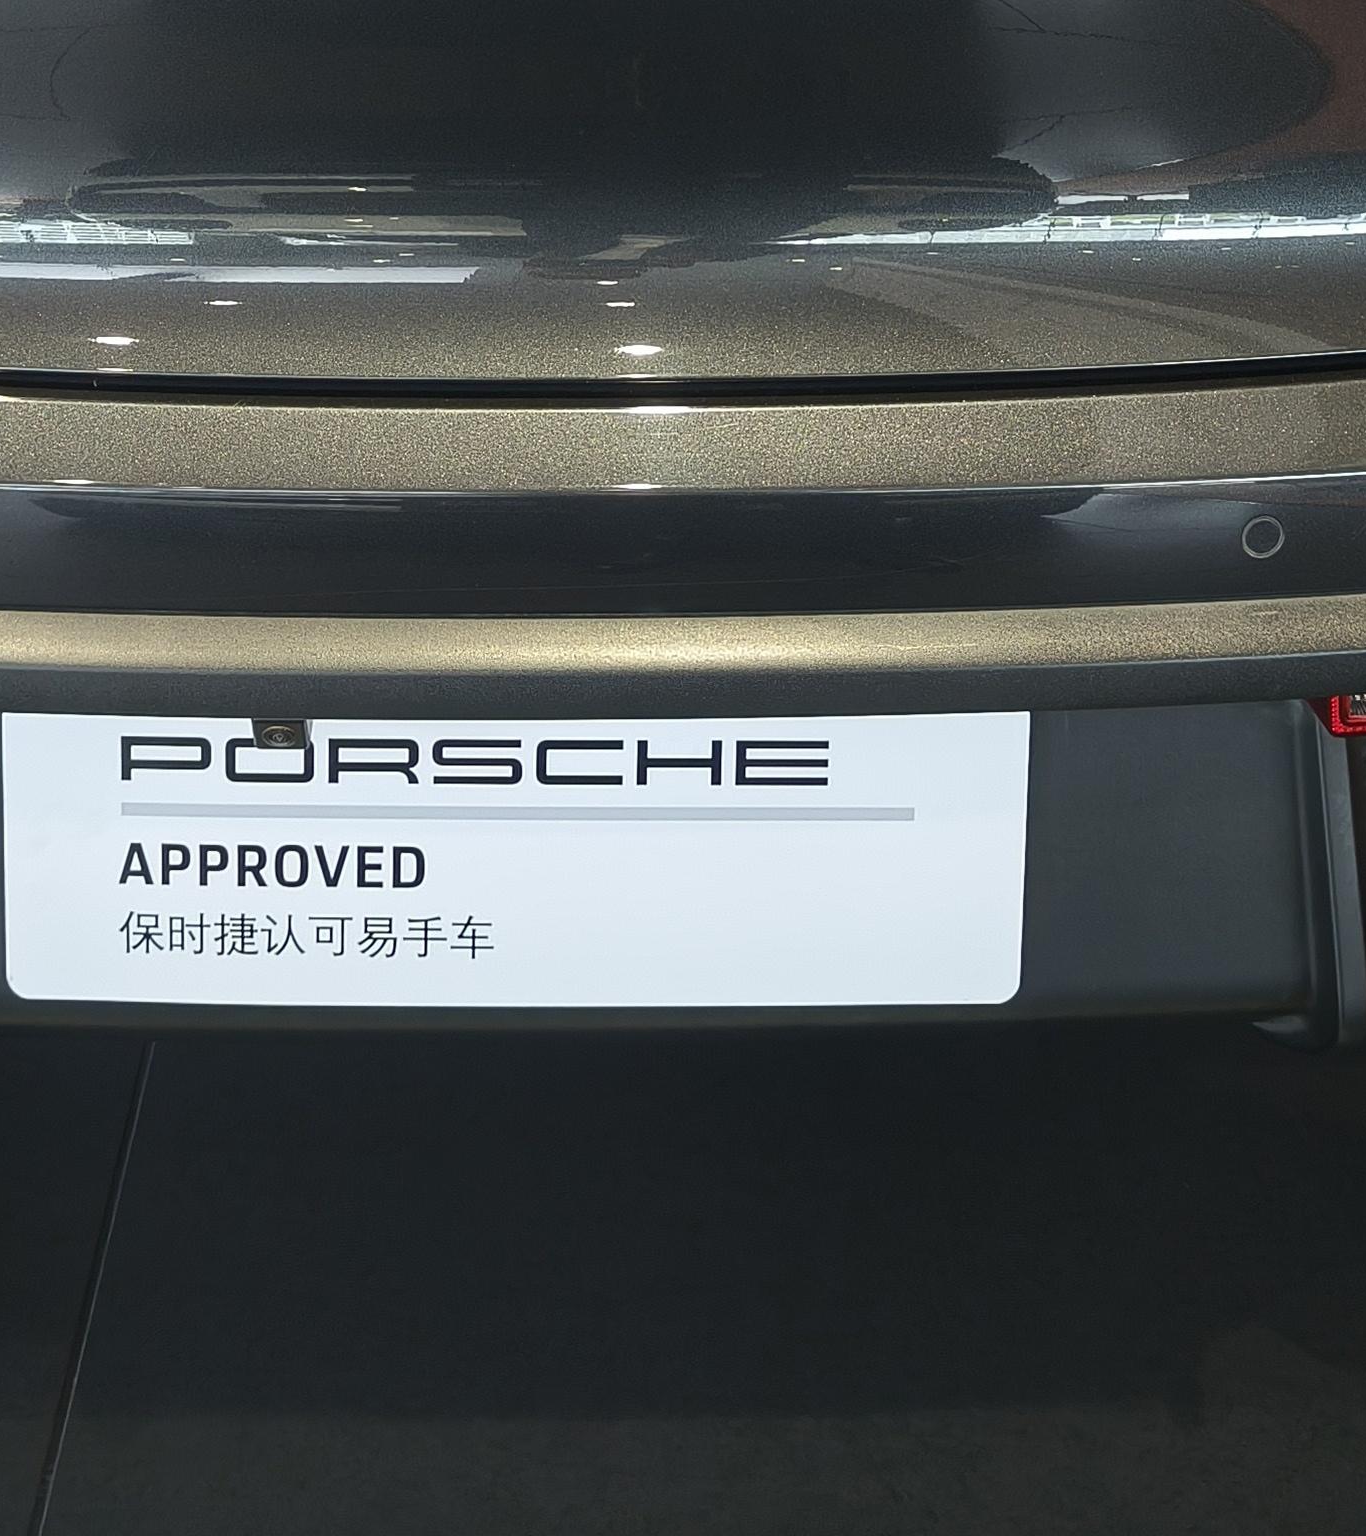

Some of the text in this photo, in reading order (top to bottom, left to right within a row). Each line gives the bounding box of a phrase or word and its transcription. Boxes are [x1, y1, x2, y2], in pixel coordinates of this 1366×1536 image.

[121, 735, 830, 787] PORSCHE
[119, 842, 426, 890] APPROVED
[119, 909, 495, 960] 保时捷认可易手车
